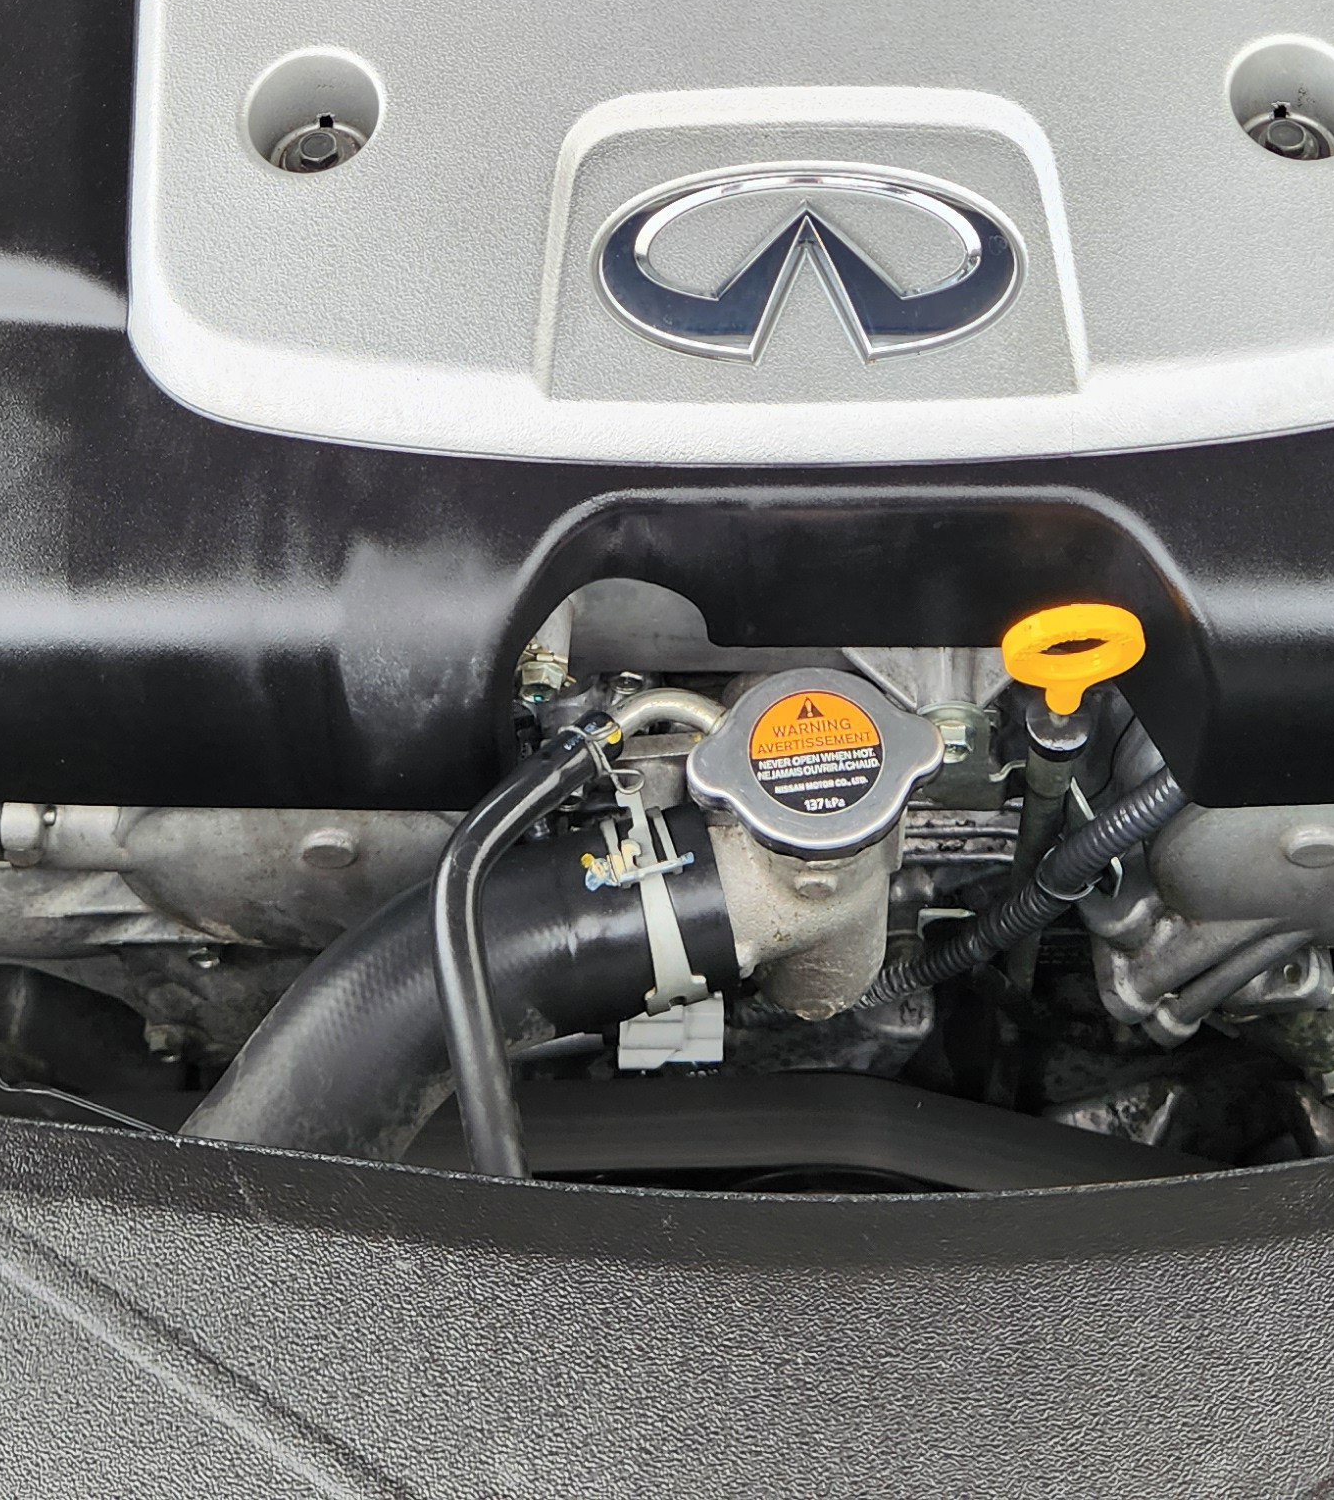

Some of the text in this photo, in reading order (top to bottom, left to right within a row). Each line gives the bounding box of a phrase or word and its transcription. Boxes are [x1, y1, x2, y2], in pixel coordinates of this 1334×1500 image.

[772, 718, 851, 738] WARNING
[758, 731, 873, 754] AVERTISSEMENT
[758, 747, 876, 770] NEVER OPEN WHEN HOT.
[769, 767, 803, 780] JAMAIS
[803, 762, 838, 776] OUVRIR
[774, 782, 805, 794] NISSAN
[805, 779, 835, 791] MOTOR
[804, 797, 846, 811] 137 kPa
